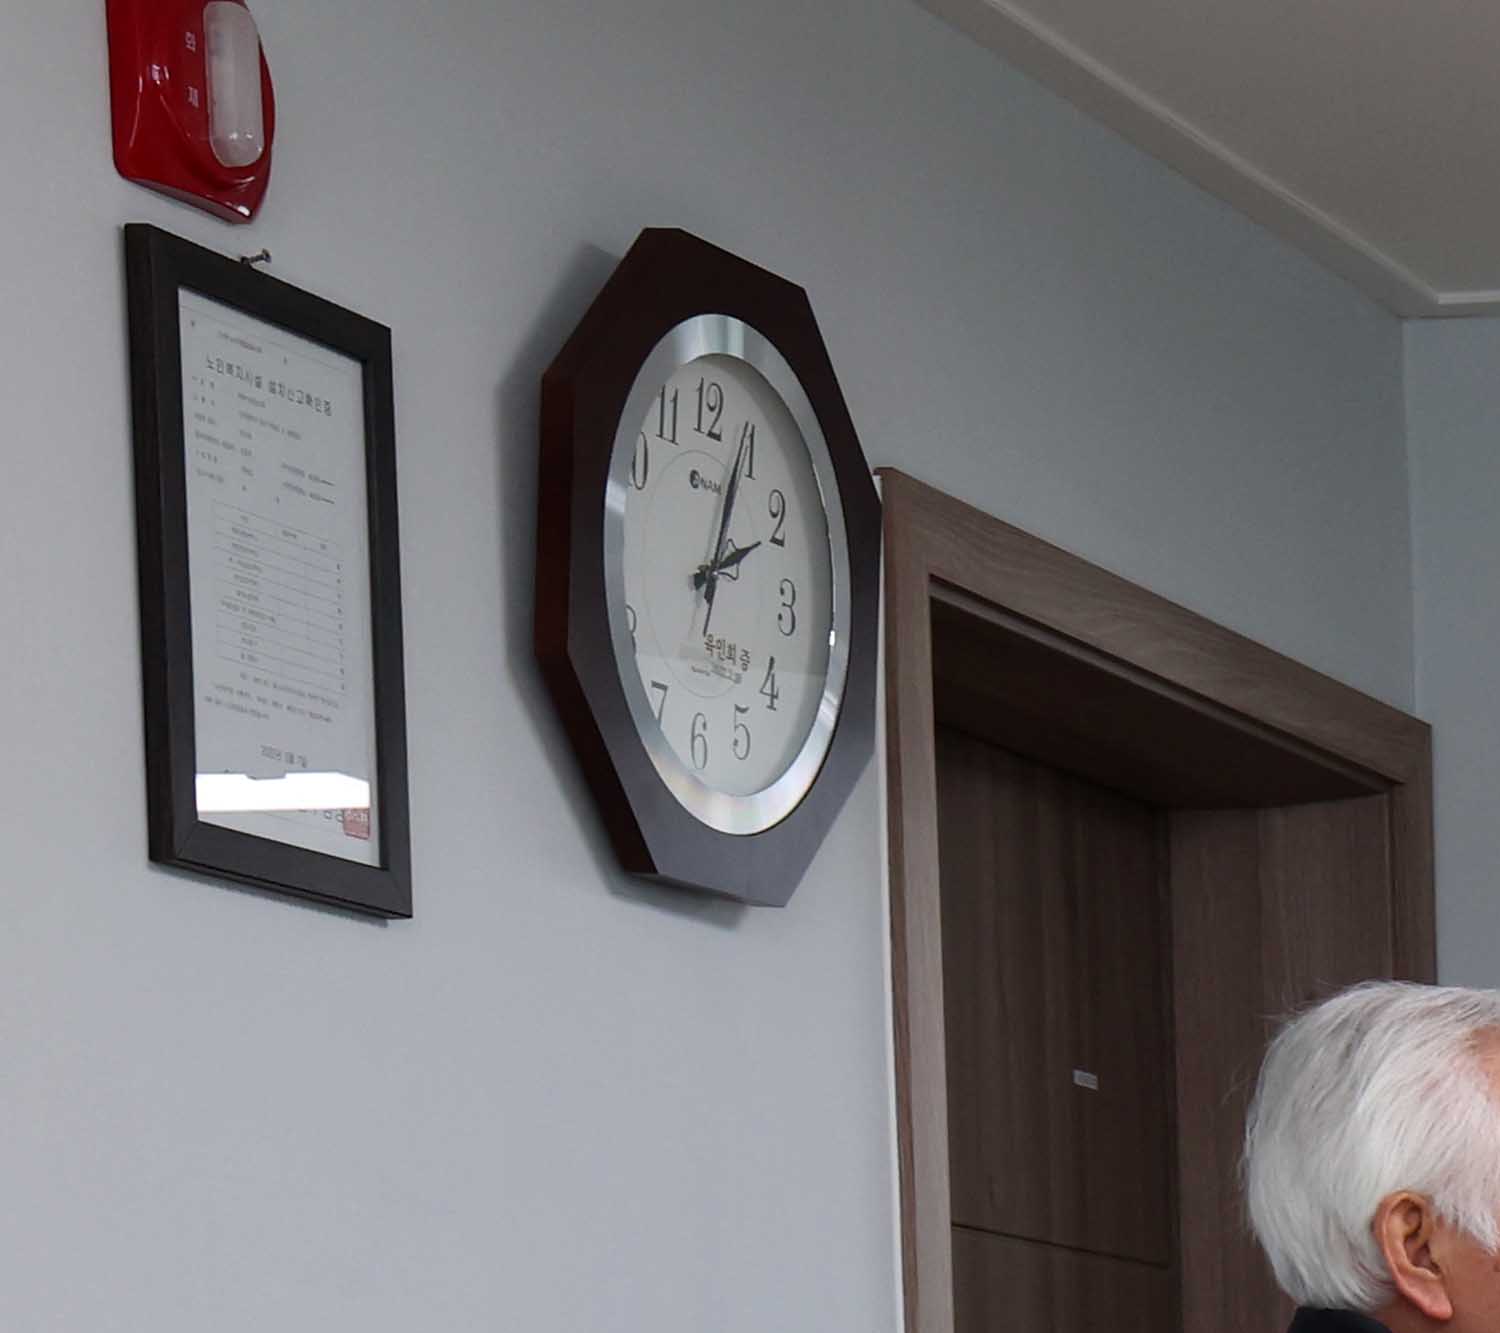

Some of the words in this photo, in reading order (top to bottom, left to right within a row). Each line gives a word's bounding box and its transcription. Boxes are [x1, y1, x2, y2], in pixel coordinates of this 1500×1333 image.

[656, 383, 679, 446] 11
[693, 376, 724, 442] 12
[631, 431, 648, 491] 0
[768, 488, 785, 548] 2
[777, 577, 796, 637] 3
[650, 679, 669, 722] 7
[759, 655, 779, 712] 4
[690, 712, 708, 770] 6
[732, 703, 751, 761] 5
